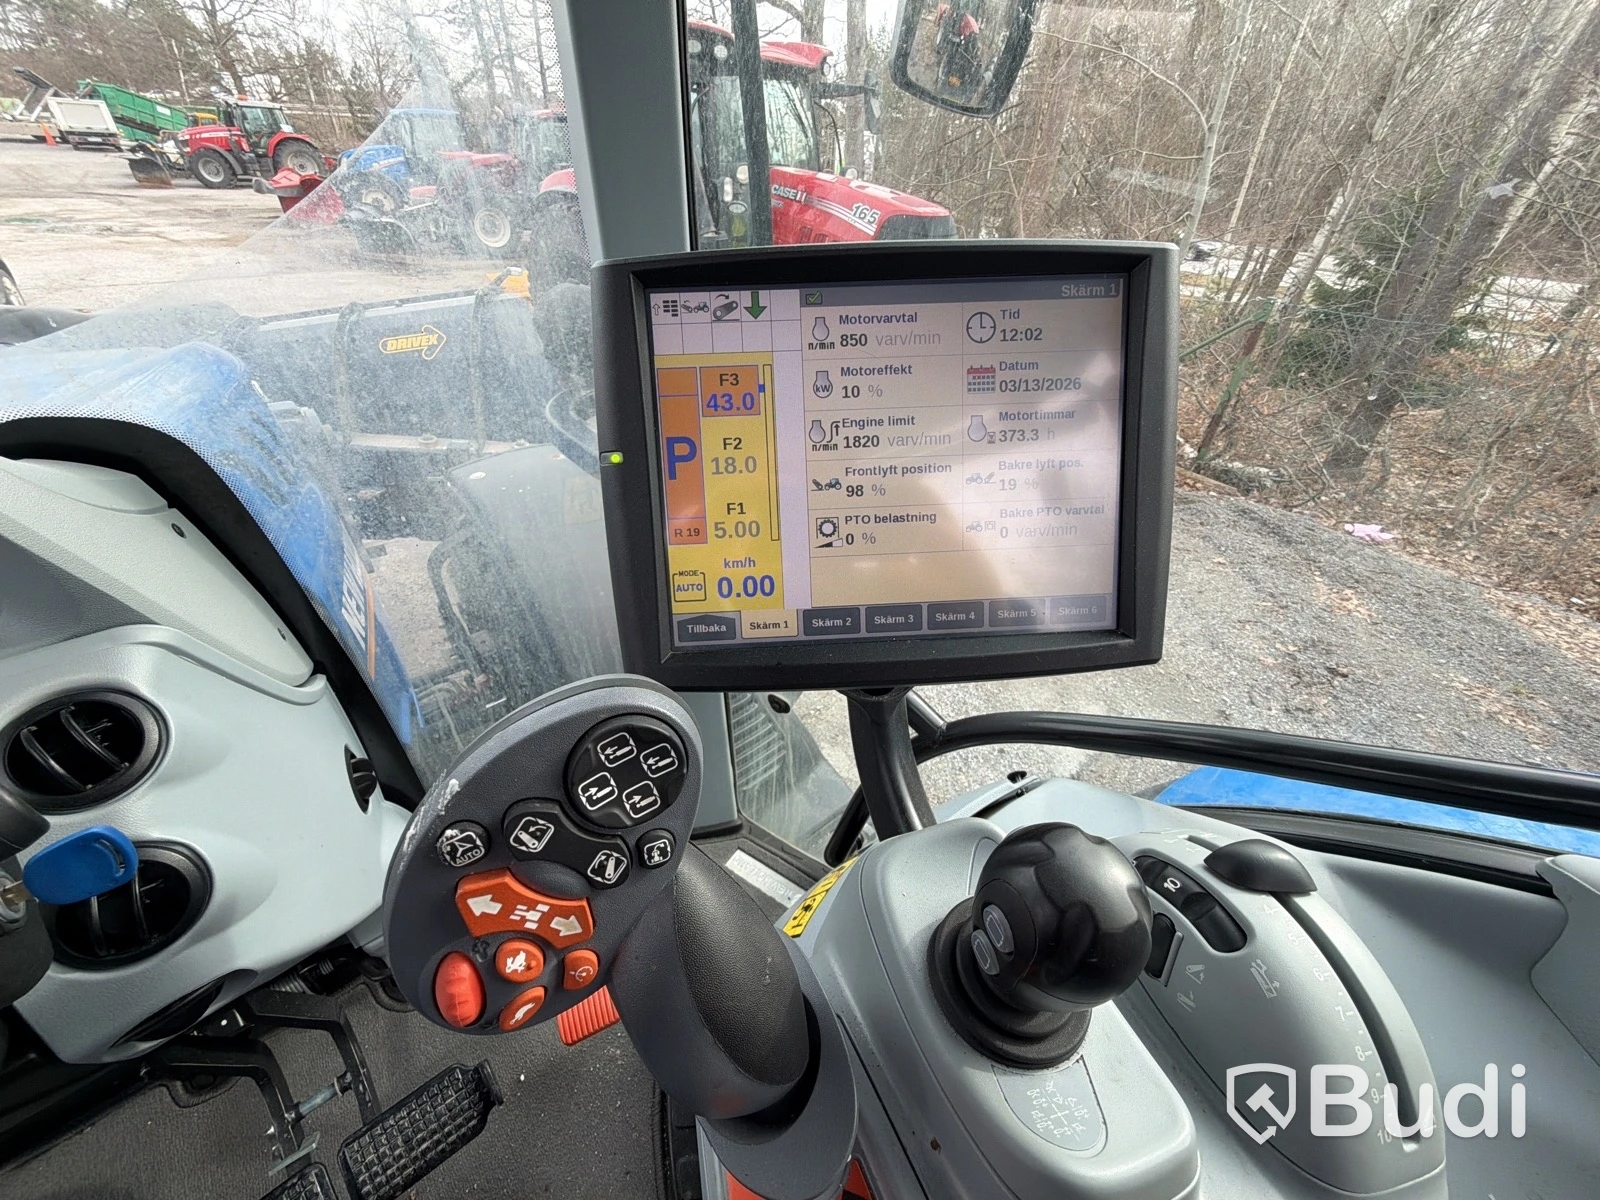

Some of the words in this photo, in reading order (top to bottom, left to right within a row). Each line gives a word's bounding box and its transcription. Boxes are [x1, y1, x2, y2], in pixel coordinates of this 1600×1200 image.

[771, 184, 797, 200] CASE
[852, 203, 880, 225] 165
[1061, 284, 1104, 297] Skärm
[1109, 283, 1117, 296] 1
[839, 312, 918, 325] Motorvarvtal
[1000, 308, 1020, 320] Tid
[840, 333, 868, 347] 850
[875, 330, 941, 346] varv/min
[1000, 327, 1043, 342] 12:02
[386, 334, 439, 351] DRIVEX
[840, 364, 913, 377] Motoreffekt
[999, 360, 1039, 372] Datum
[719, 373, 740, 387] F3
[999, 377, 1082, 393] 03/13/2026
[815, 384, 831, 393] kW
[842, 385, 860, 399] 10
[867, 384, 883, 398] %
[706, 392, 755, 412] 43.0
[842, 416, 884, 430] Engine
[888, 415, 916, 427] limit
[998, 410, 1076, 422] Motortimmar
[843, 434, 880, 449] 1820
[887, 432, 951, 447] varv/min
[998, 428, 1039, 443] 373.3
[1047, 427, 1055, 440] h
[722, 437, 743, 451] F2
[665, 436, 698, 481] P
[710, 455, 758, 475] 18.0
[998, 460, 1033, 471] Bakre
[1036, 458, 1055, 472] lyft
[845, 464, 898, 478] Frontlyft
[901, 463, 952, 477] position
[846, 485, 864, 498] 98
[871, 483, 886, 497] %
[999, 478, 1017, 492] 19
[726, 502, 746, 516] F1
[1000, 508, 1033, 519] Bakre
[1036, 506, 1062, 517] PTO
[845, 515, 871, 525] PTO
[874, 511, 937, 524] belastning
[674, 528, 683, 538] R
[686, 527, 700, 537] 19
[714, 520, 761, 540] 5.00
[1000, 526, 1009, 539] 0
[1016, 524, 1077, 538] varv/min
[845, 533, 854, 546] 0
[861, 532, 877, 545] %
[723, 557, 756, 569] km/h
[676, 583, 703, 593] AUTO
[717, 574, 775, 599] 0.00
[935, 612, 966, 622] Skärm
[968, 611, 975, 620] 4
[997, 609, 1028, 619] Skärm
[1030, 608, 1037, 617] 5
[1058, 606, 1089, 616] Skärm
[1091, 605, 1098, 615] 6
[749, 620, 781, 631] Skärm
[783, 620, 789, 629] 1
[811, 618, 843, 628] Skärm
[845, 617, 852, 626] 2
[874, 615, 905, 625] Skärm
[907, 614, 914, 623] 3
[686, 623, 727, 634] Tillbaka
[456, 849, 481, 865] AUTO
[1163, 877, 1181, 893] 10
[1313, 967, 1325, 981] 6
[1335, 1006, 1345, 1020] 7
[1355, 1045, 1366, 1061] 8
[1370, 1087, 1380, 1105] 9
